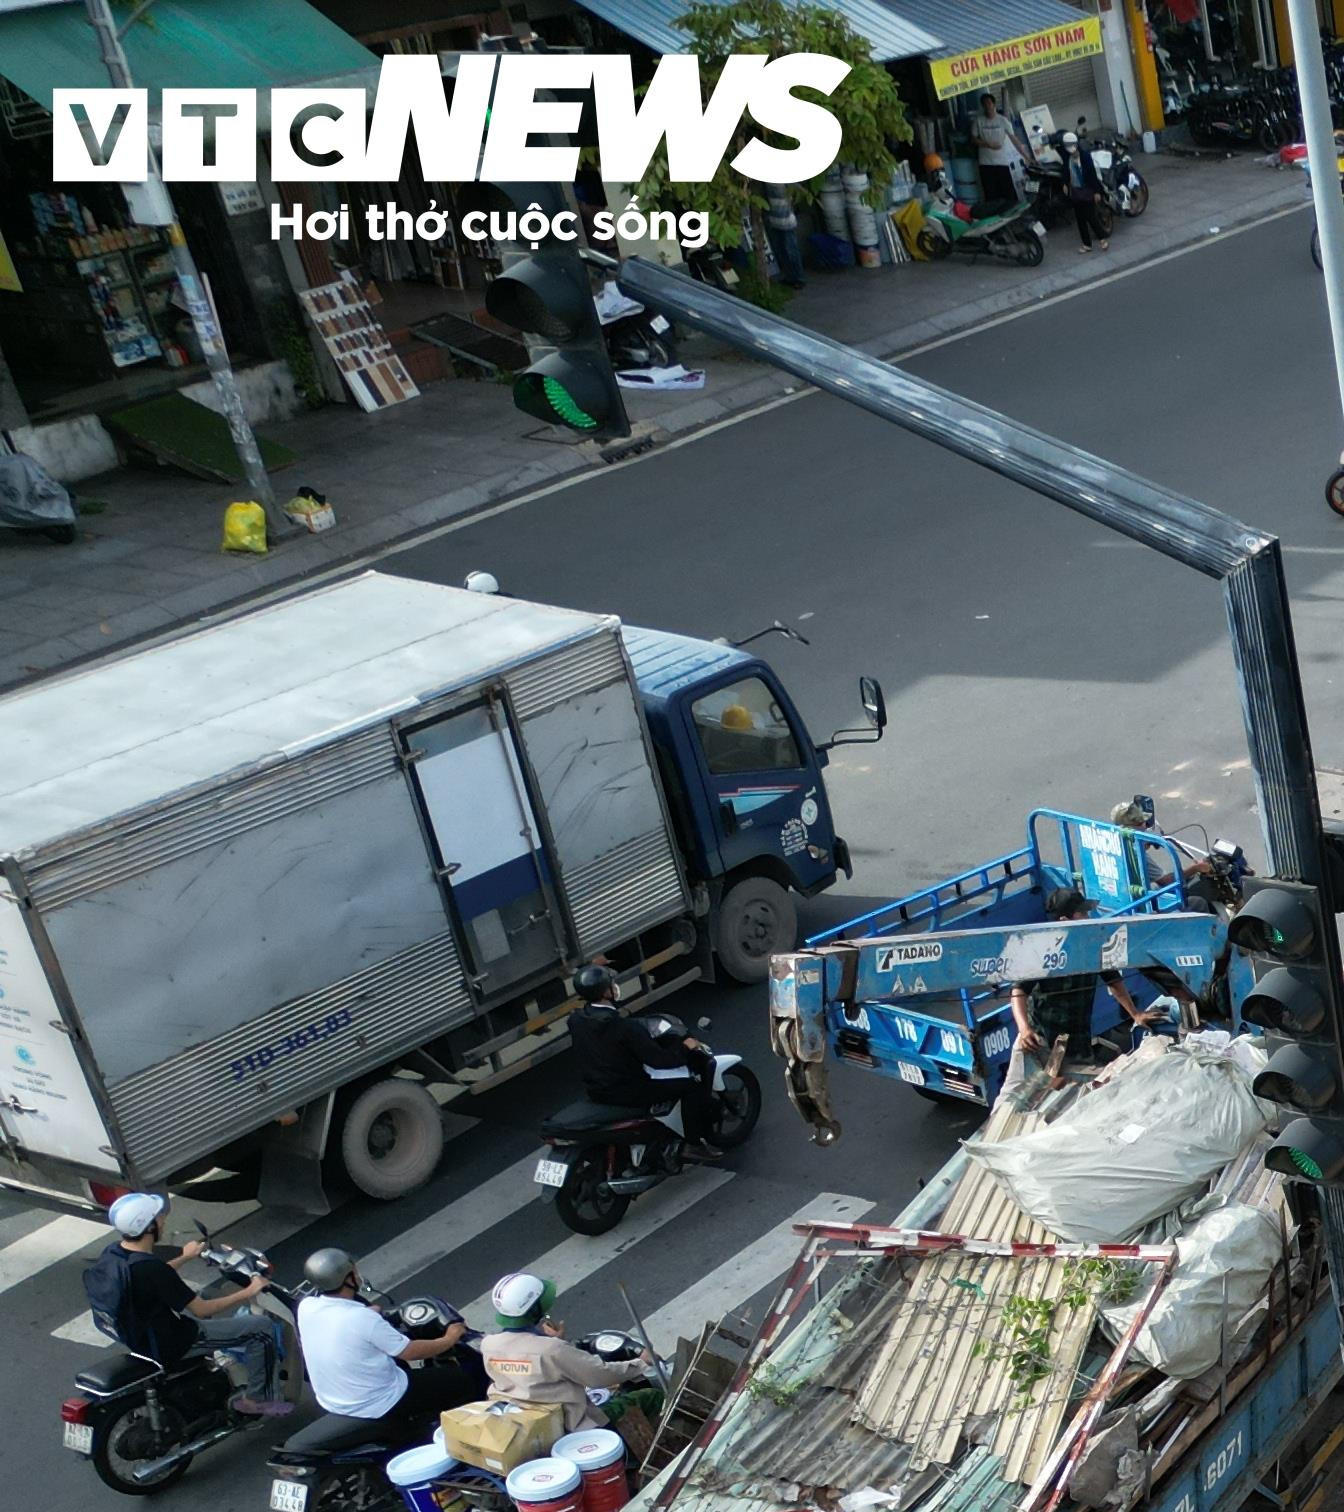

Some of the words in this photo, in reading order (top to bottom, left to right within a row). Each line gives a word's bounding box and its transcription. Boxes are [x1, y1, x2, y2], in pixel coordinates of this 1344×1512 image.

[951, 56, 980, 78] CỬA
[1024, 34, 1052, 56] SƠN
[1055, 27, 1085, 48] NAM
[898, 944, 941, 960] TADANO
[984, 1027, 1010, 1058] 0908
